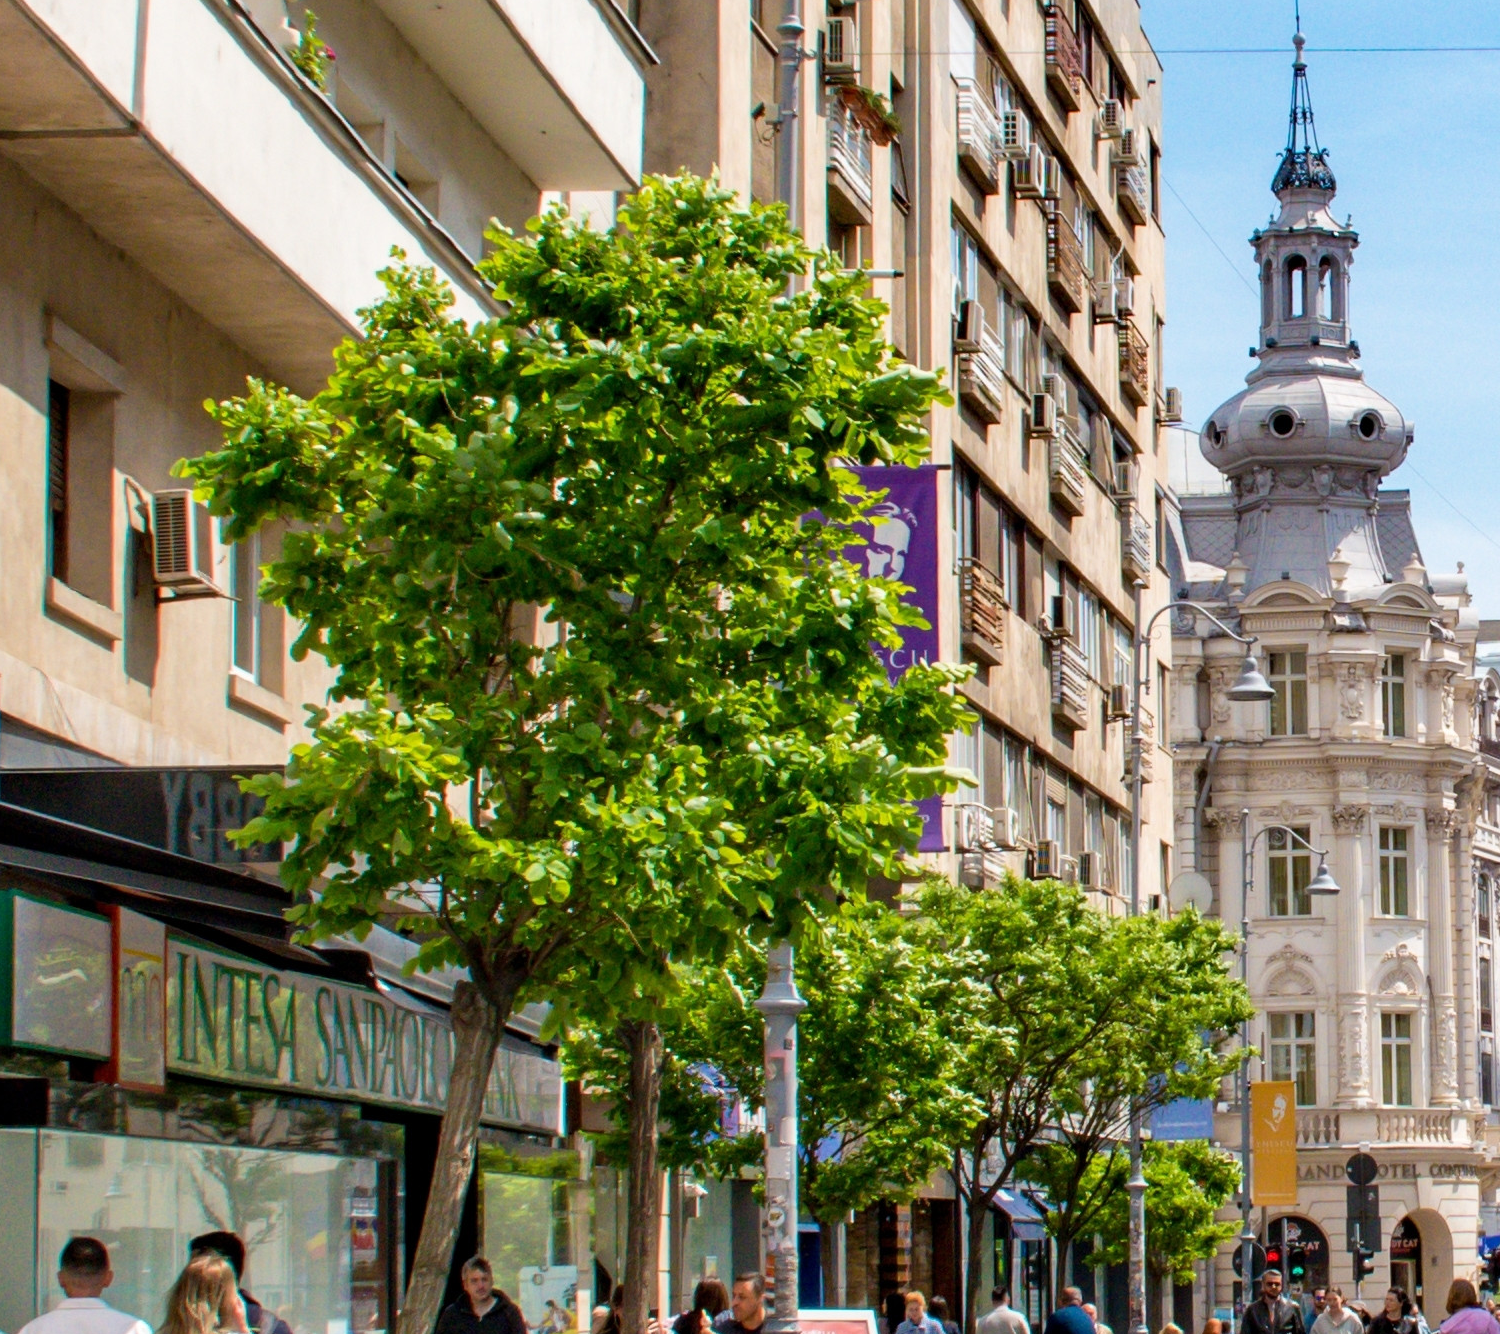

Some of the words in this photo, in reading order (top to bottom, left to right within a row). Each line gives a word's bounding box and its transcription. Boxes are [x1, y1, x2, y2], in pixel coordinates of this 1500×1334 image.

[175, 951, 299, 1084] INTESA
[1297, 1163, 1345, 1179] AND
[1376, 1163, 1421, 1179] OTEL
